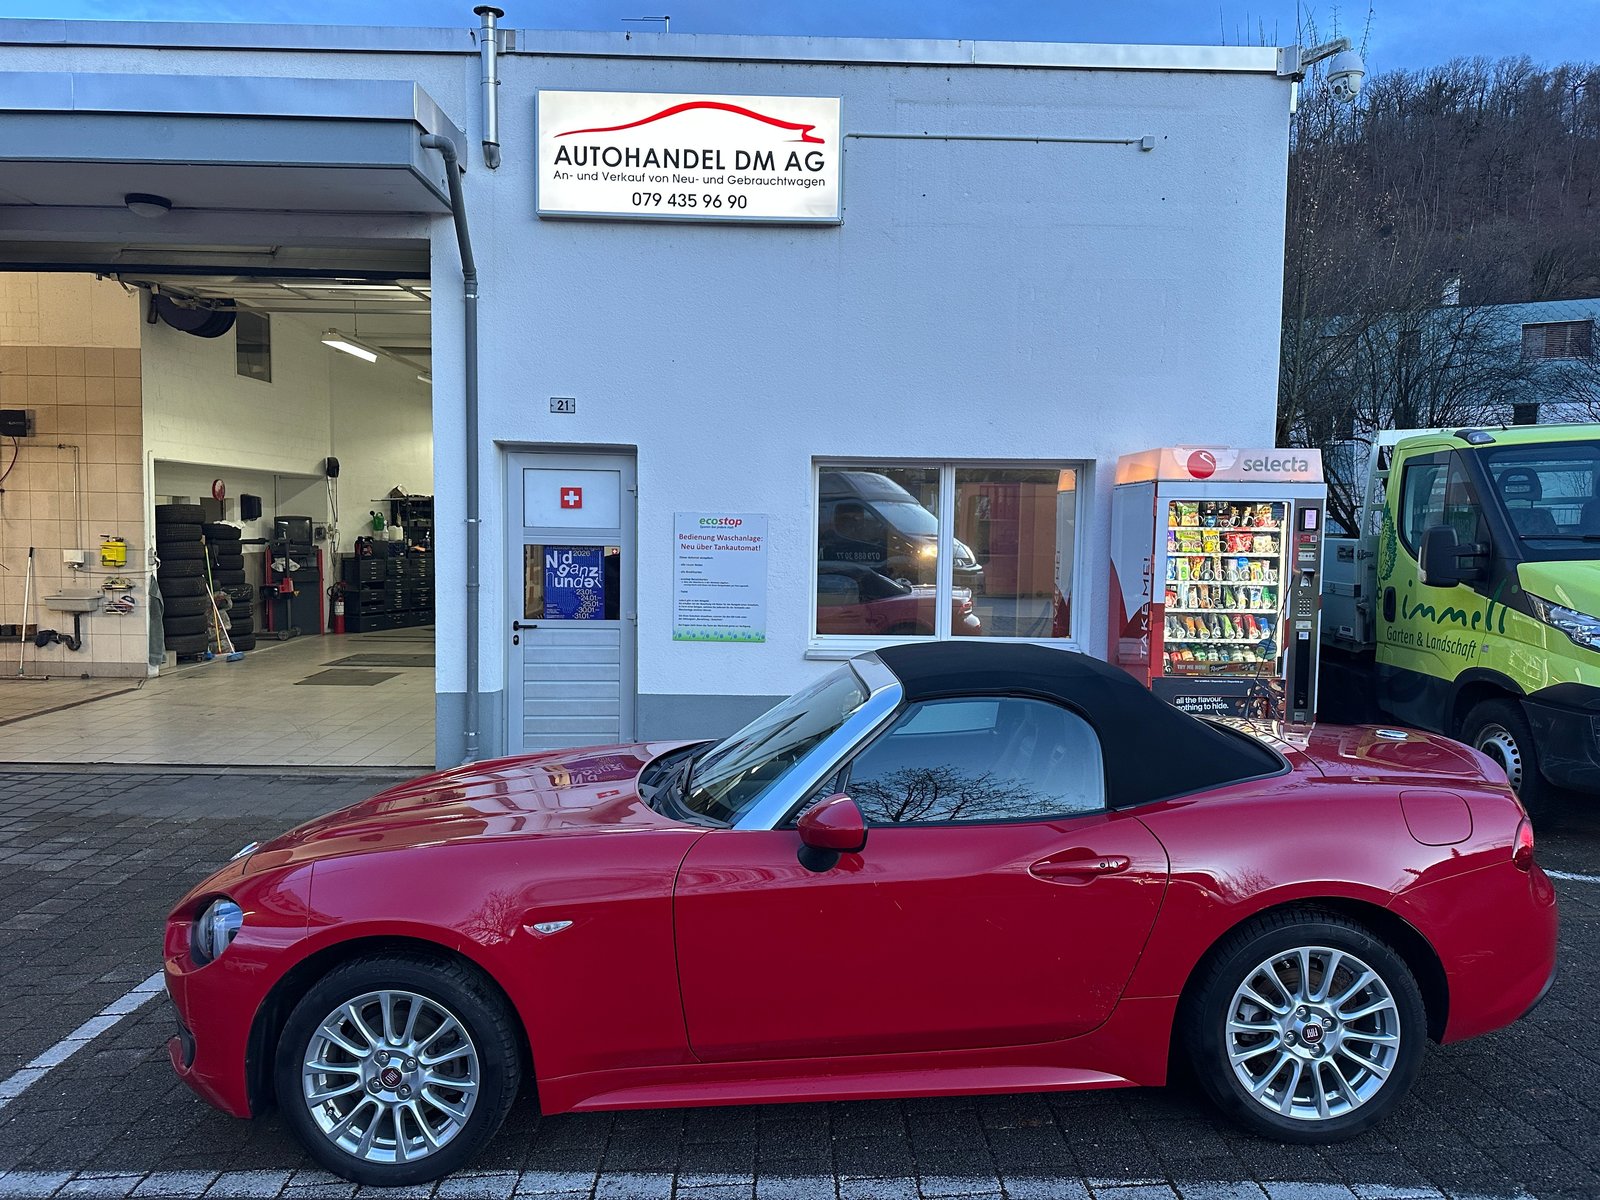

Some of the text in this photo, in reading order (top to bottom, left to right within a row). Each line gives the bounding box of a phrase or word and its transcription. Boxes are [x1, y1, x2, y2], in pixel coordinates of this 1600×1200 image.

[554, 145, 826, 172] AUTOHANDEL DM AG
[553, 170, 826, 188] An- und Verkauf von Neu- und Gebrauchtwagen
[632, 192, 747, 209] 079 435 96 90
[557, 400, 570, 411] 21
[1243, 456, 1309, 473] selecta
[699, 517, 742, 527] ecostop
[679, 533, 764, 543] Bedienung Waschanlage:
[697, 543, 712, 551] über
[714, 543, 761, 552] Tankautomat!
[546, 550, 572, 568] Nid
[1140, 603, 1148, 659] TAKE
[1386, 626, 1476, 661] Garten & Landschaft
